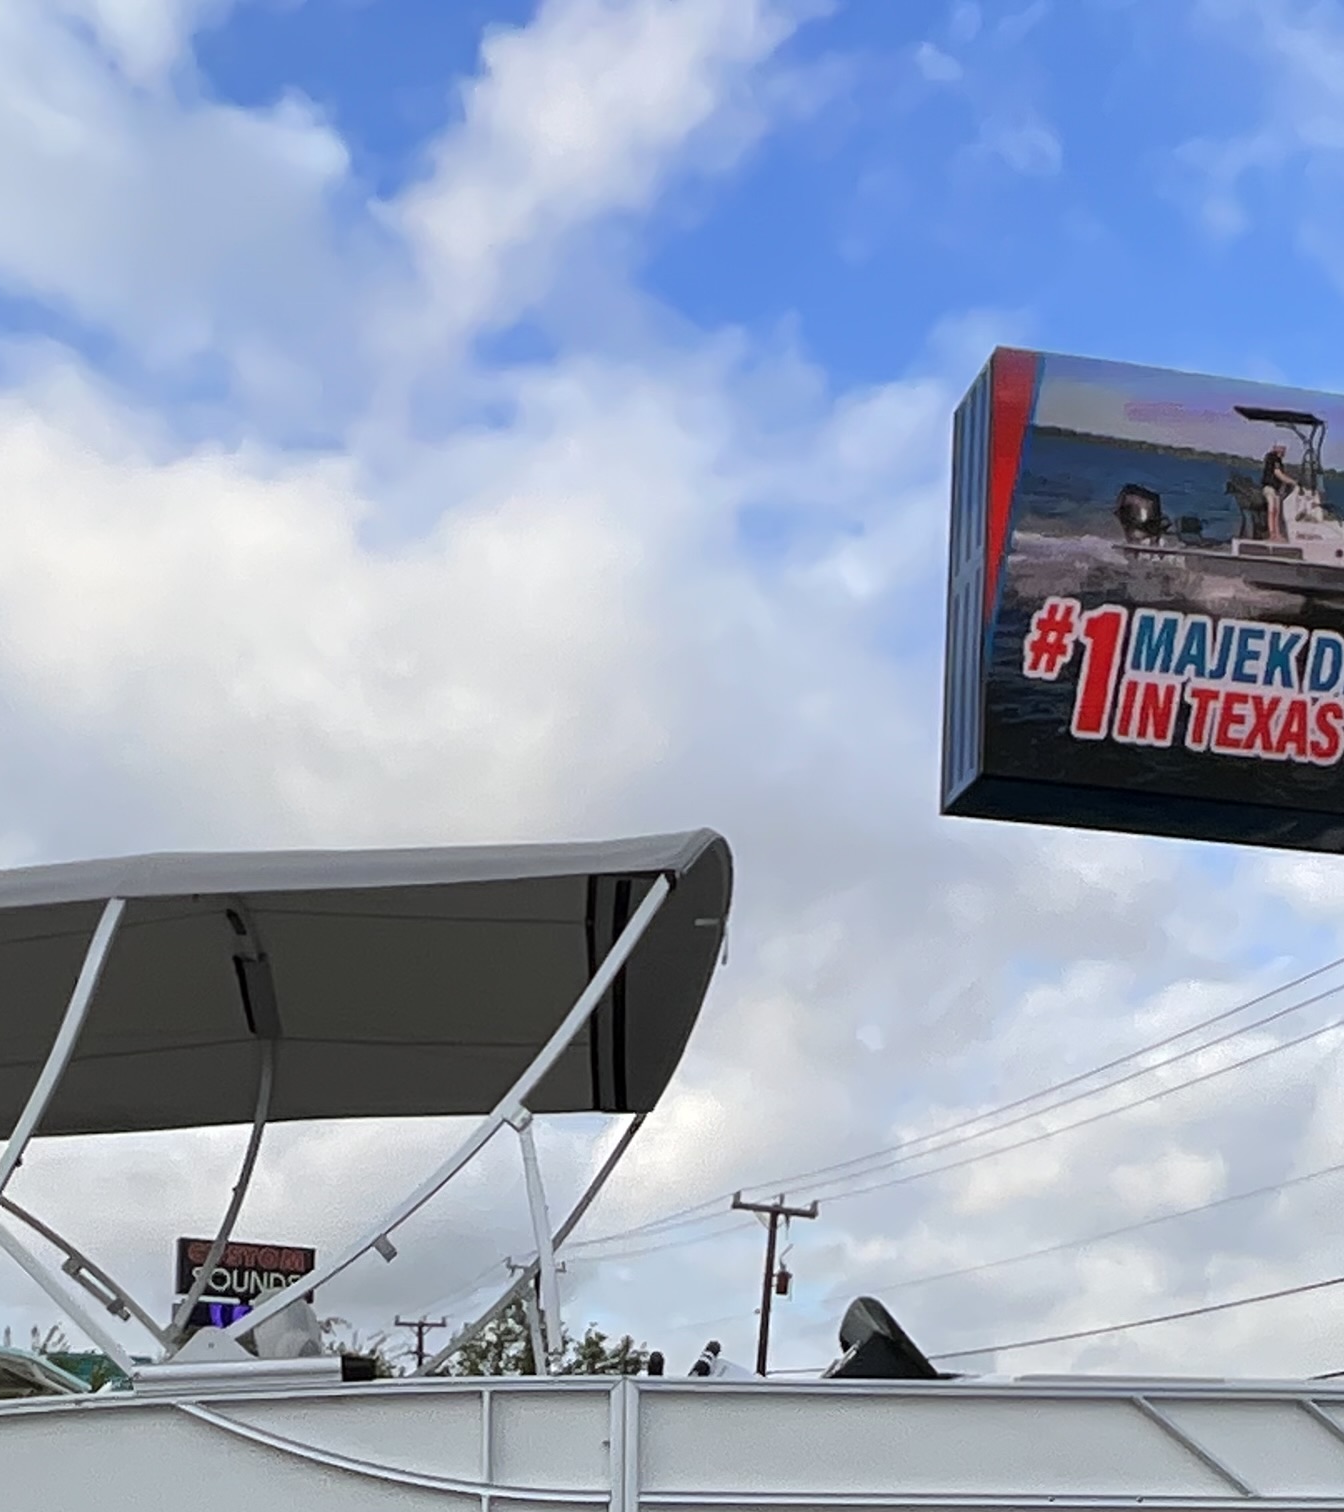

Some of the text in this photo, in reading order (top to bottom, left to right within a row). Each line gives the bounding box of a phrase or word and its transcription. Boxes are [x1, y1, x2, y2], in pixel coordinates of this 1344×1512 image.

[1026, 602, 1125, 737] #1
[1130, 610, 1304, 691] MAJEK
[1116, 680, 1177, 741] IN
[188, 1242, 305, 1273] CSTOM
